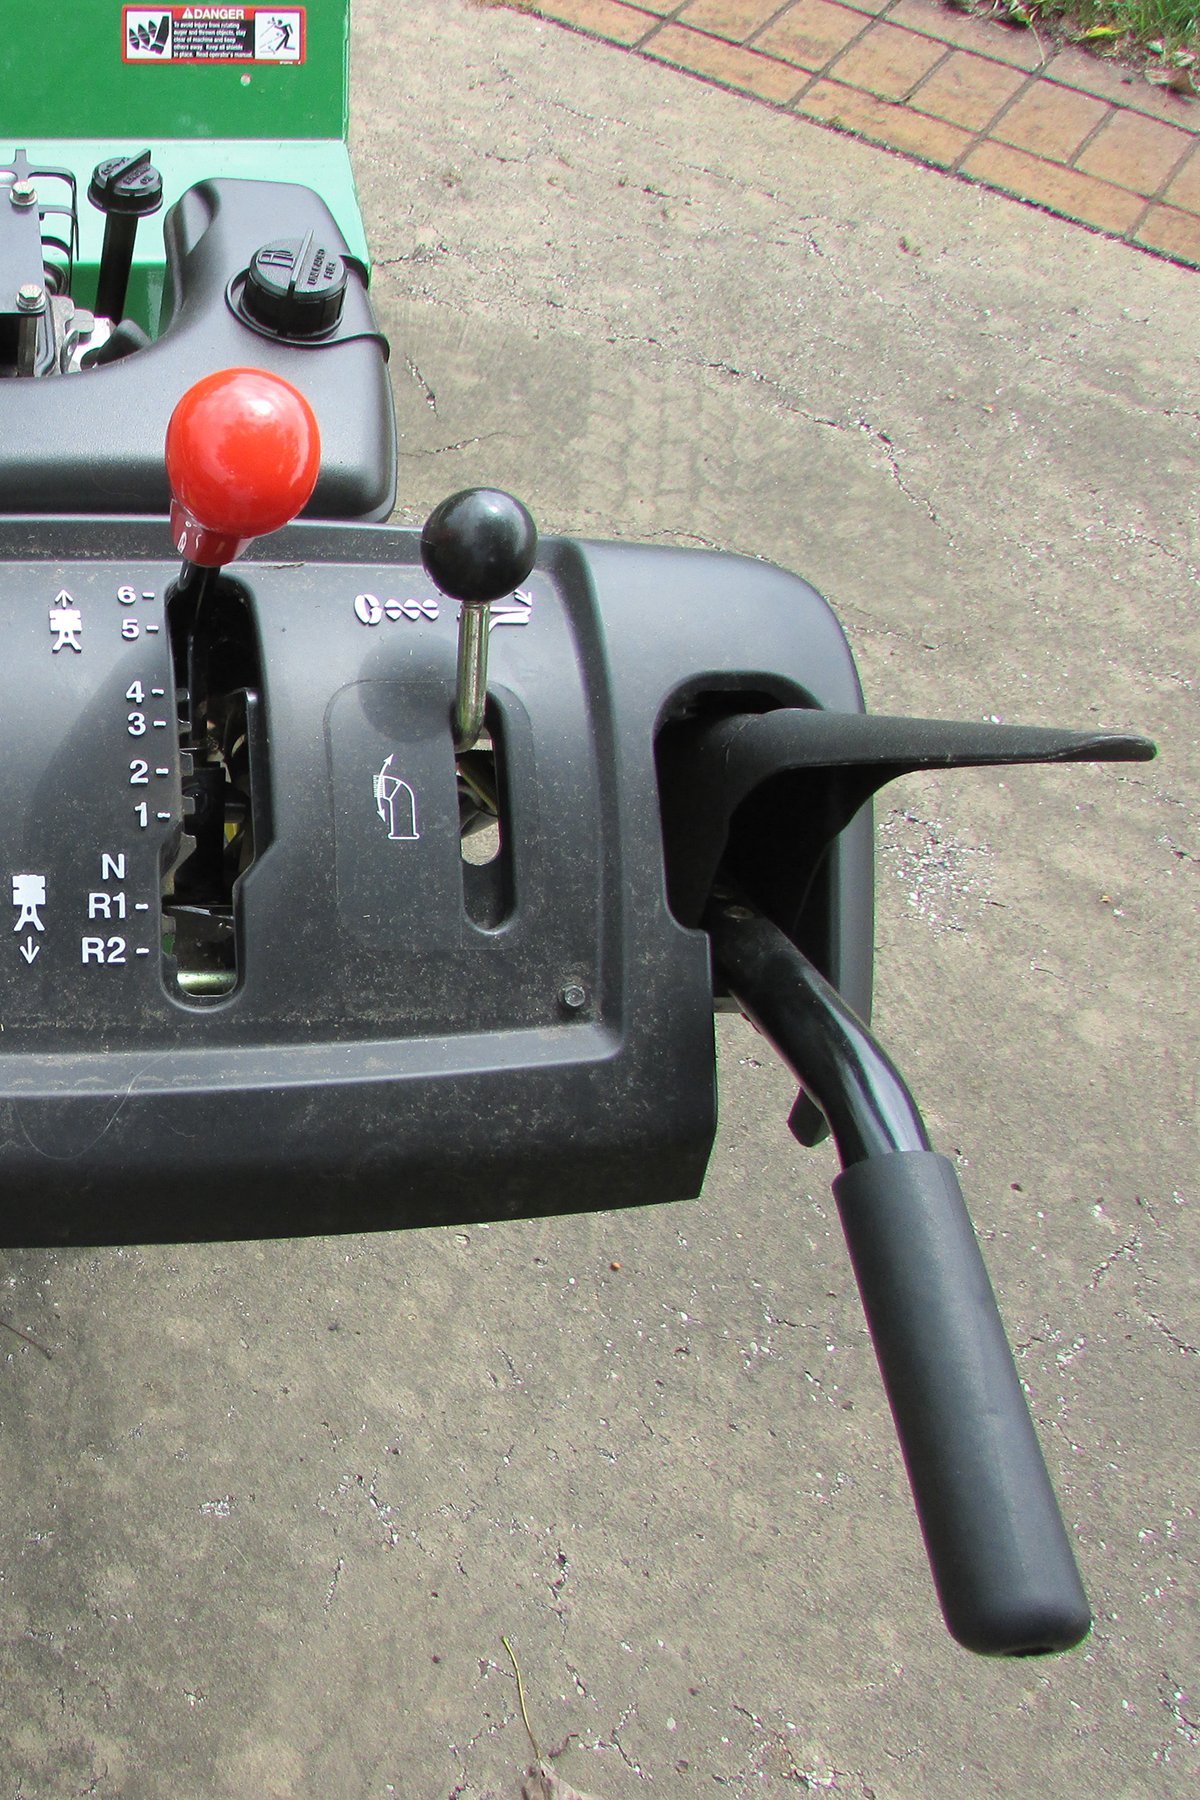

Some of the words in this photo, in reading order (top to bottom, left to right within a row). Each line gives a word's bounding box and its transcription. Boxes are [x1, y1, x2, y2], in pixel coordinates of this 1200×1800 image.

[194, 9, 244, 19] DANGER
[194, 21, 208, 29] injury
[221, 21, 240, 29] rotating
[101, 853, 126, 880] N
